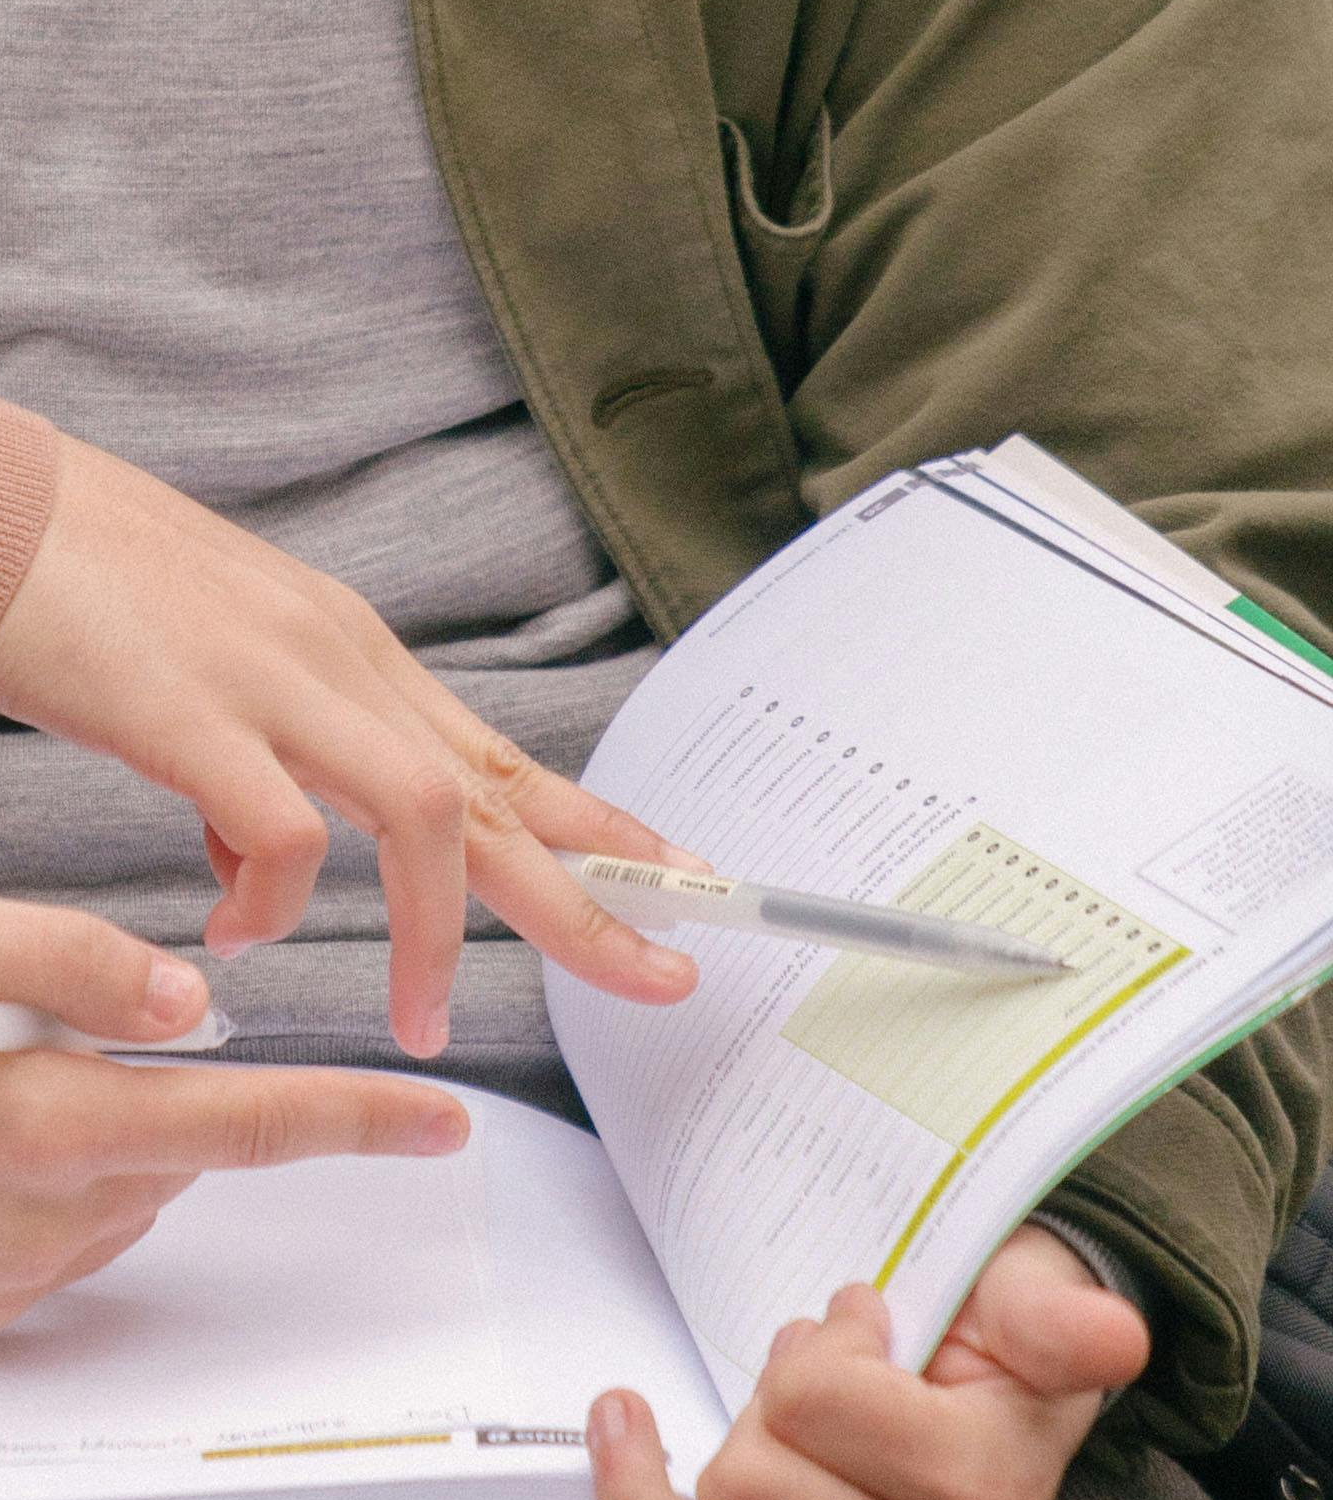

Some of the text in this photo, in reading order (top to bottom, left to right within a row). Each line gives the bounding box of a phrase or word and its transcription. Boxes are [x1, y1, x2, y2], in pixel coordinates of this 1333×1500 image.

[772, 542, 822, 584] Listening
[752, 580, 774, 599] and
[705, 595, 755, 640] Speaking
[663, 701, 737, 781] memorization:
[687, 714, 763, 795] interpretation:
[725, 730, 787, 793] interaction:
[747, 746, 813, 811] formulation:
[776, 761, 838, 821] evaluation:
[927, 806, 963, 837] Many
[891, 835, 929, 869] words
[873, 866, 894, 887] can
[779, 968, 802, 993] the
[796, 951, 815, 972] by
[744, 991, 785, 1042] addition
[749, 993, 771, 1017] the
[709, 1014, 755, 1071] meaning
[732, 1041, 750, 1059] of
[683, 1085, 709, 1122] each
